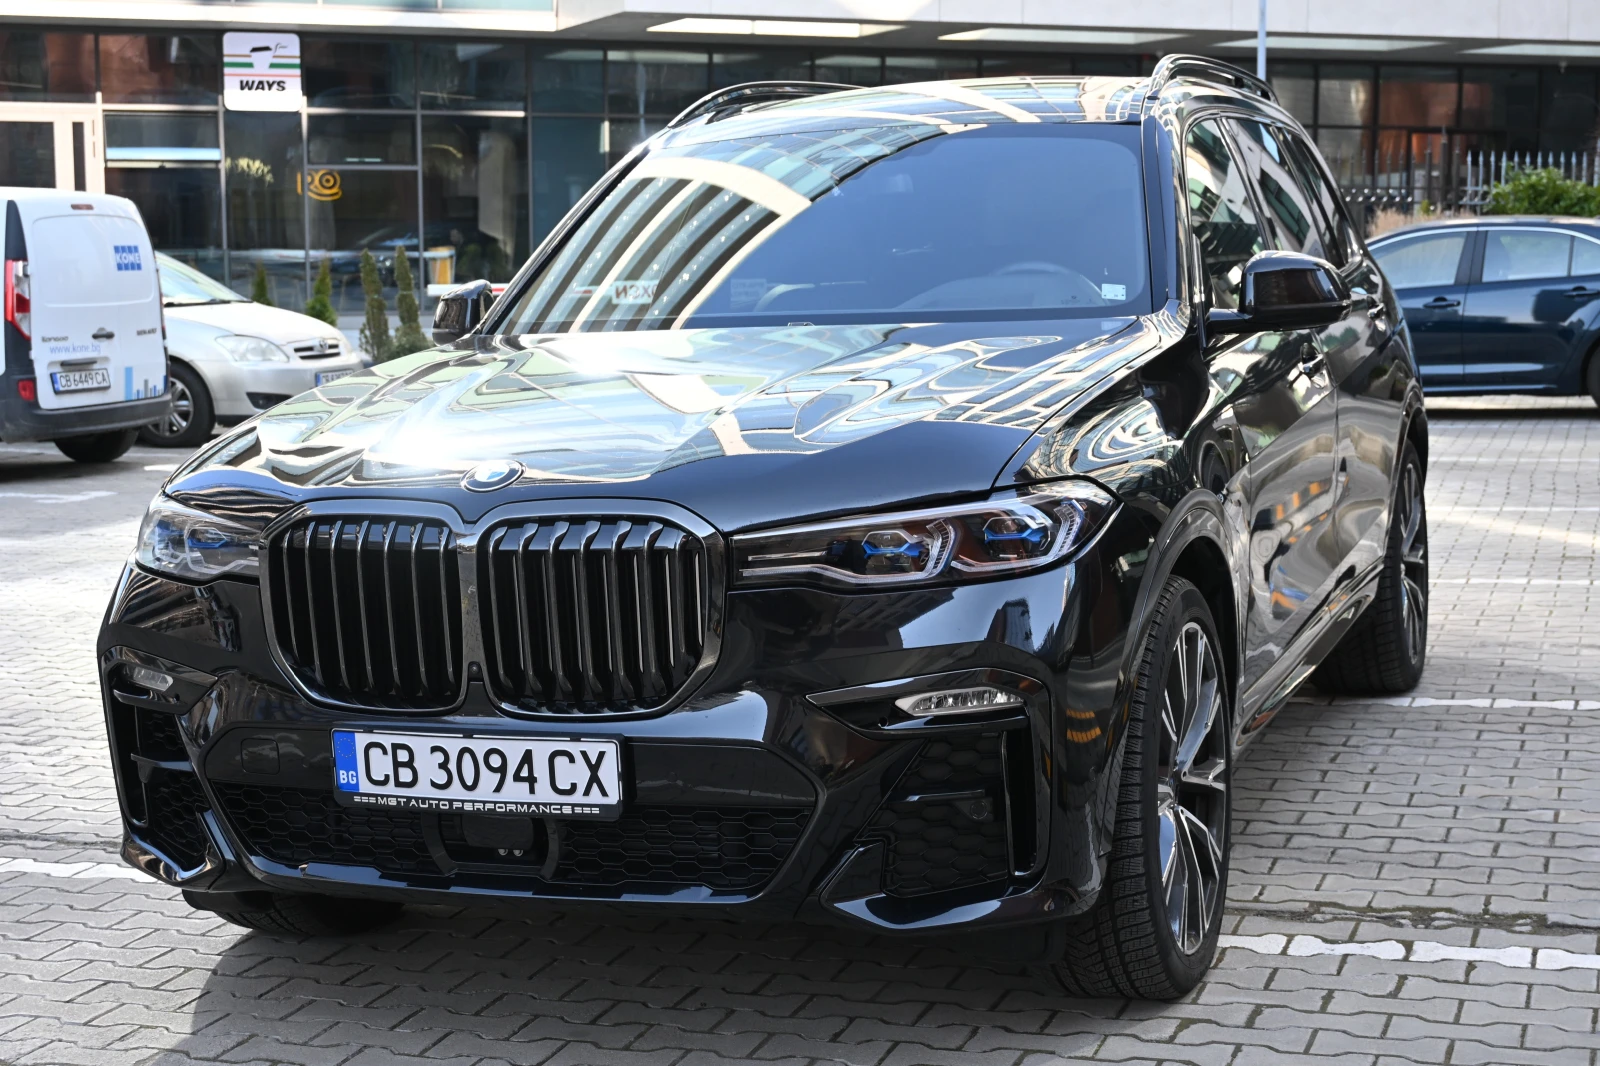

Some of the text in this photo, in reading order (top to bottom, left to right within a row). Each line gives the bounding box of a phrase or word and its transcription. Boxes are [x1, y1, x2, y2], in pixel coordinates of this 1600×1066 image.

[240, 80, 286, 91] WAYS
[115, 252, 141, 263] KONE
[49, 342, 101, 355] www.kone.bg
[59, 374, 72, 388] CB
[73, 372, 94, 387] 6449
[339, 769, 357, 785] BG
[363, 741, 609, 798] CB 3094 CX
[409, 798, 449, 810] AUTO
[452, 801, 573, 815] PERFORMANCE
